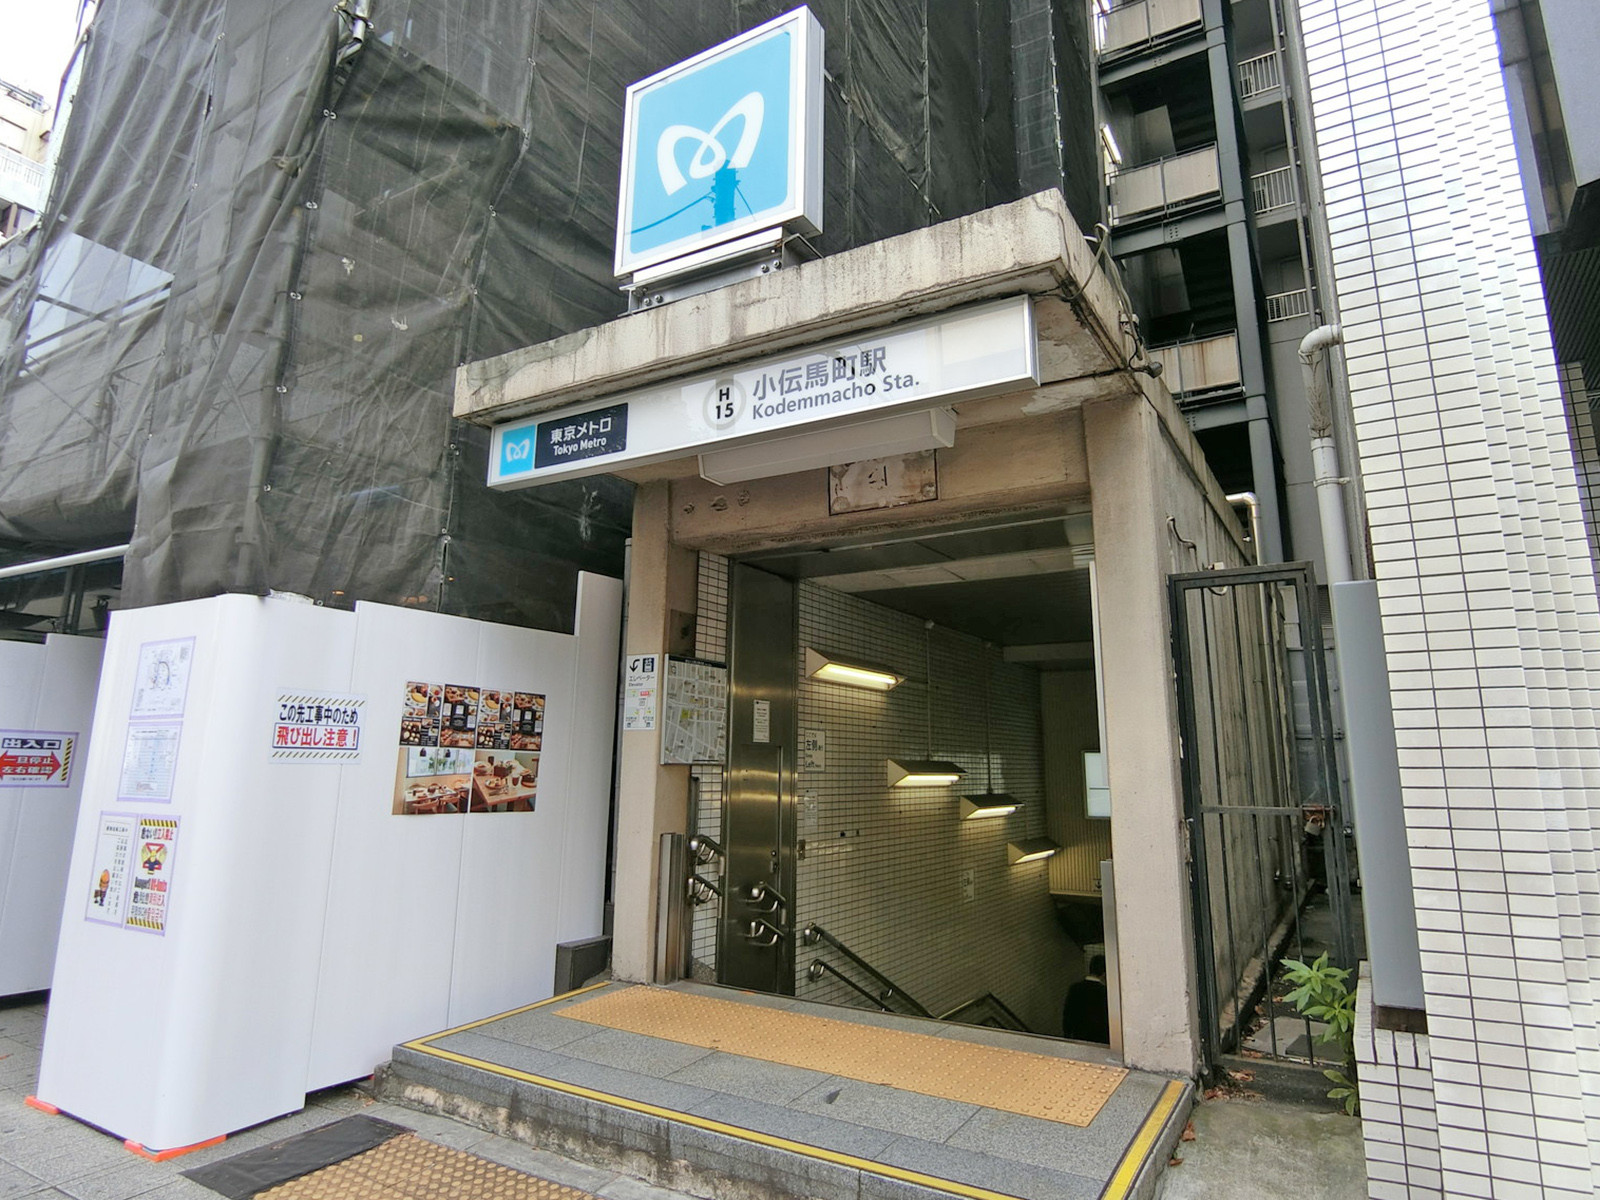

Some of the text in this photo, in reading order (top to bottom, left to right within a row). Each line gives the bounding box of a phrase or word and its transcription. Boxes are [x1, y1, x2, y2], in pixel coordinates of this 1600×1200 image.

[752, 346, 887, 401] 小伝馬町駅
[718, 387, 730, 402] H
[752, 371, 920, 420] Kodemmacho Sta.
[715, 402, 734, 420] 15
[550, 417, 612, 444] 東京メトロ
[553, 435, 607, 457] Tokyo Metro
[279, 703, 359, 726] この先工事中のため
[3, 738, 61, 749] 出入口
[276, 726, 357, 747] 飛び出し注意！
